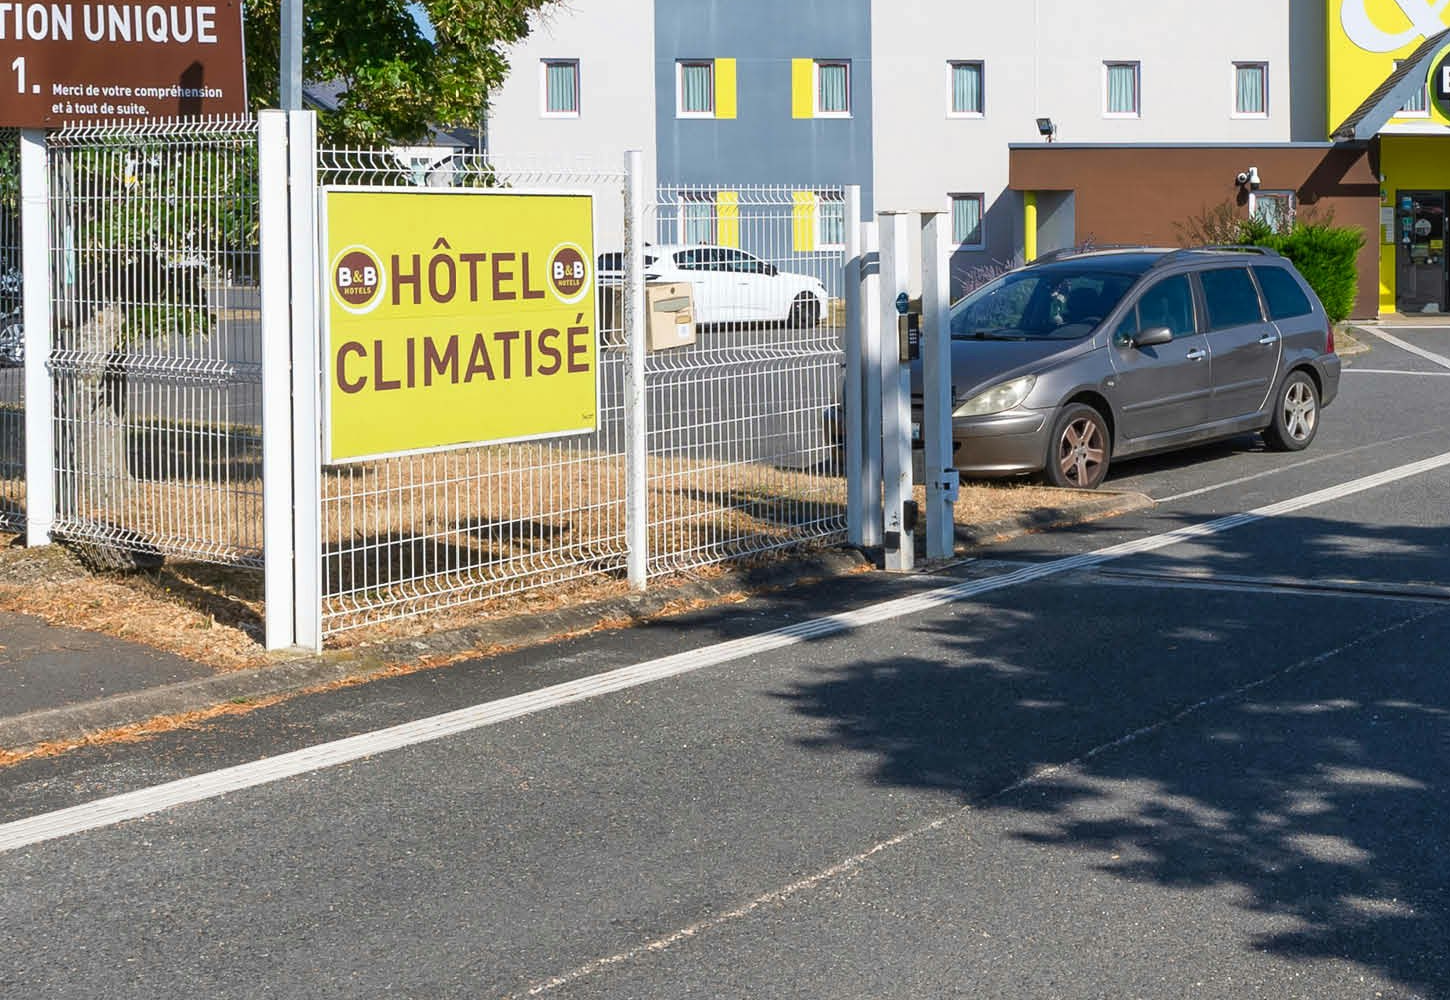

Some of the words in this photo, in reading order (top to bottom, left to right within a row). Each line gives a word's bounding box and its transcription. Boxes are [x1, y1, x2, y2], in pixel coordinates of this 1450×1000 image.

[83, 4, 218, 43] UNIQUE
[12, 56, 41, 94] 1.
[52, 83, 84, 97] Merci
[86, 84, 100, 97] de
[102, 86, 132, 98] votre
[134, 84, 223, 101] compréhension
[52, 103, 64, 115] et
[66, 101, 73, 115] à
[75, 103, 98, 115] tout
[100, 102, 115, 115] de
[117, 102, 150, 116] suite.
[338, 266, 377, 287] B&B
[391, 237, 545, 305] HÔTEL
[553, 261, 584, 280] B&B
[344, 287, 371, 295] HOTELS
[558, 279, 580, 287] HOTELS
[336, 313, 590, 394] CLIMATISÉ
